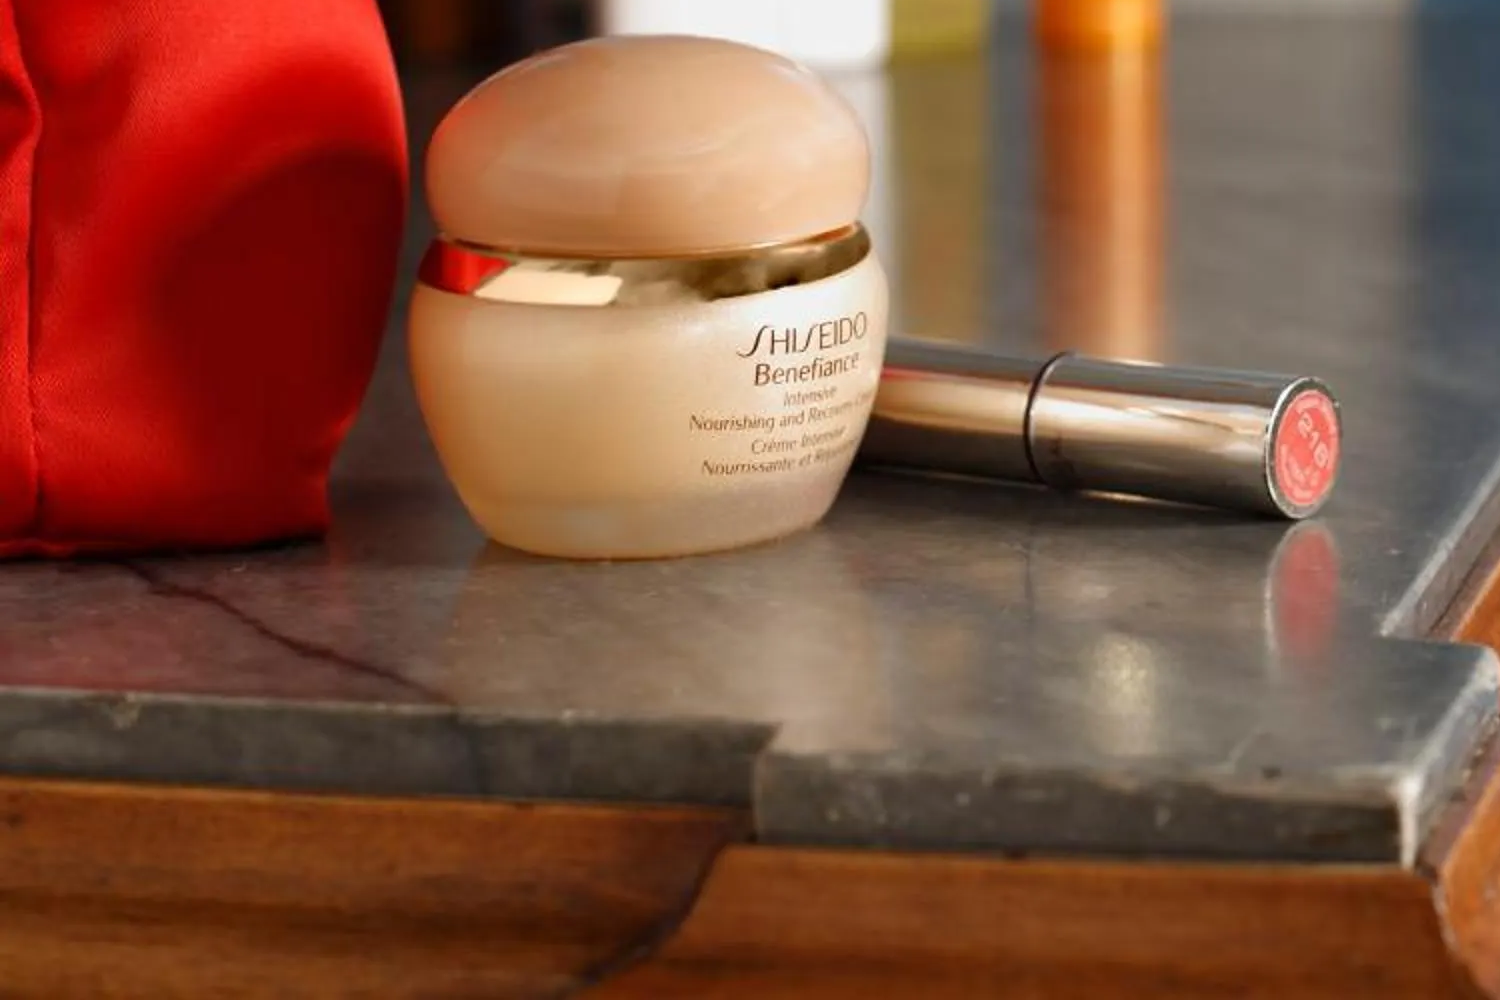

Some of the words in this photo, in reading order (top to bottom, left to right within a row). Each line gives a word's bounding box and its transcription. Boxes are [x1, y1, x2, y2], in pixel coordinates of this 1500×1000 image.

[736, 311, 867, 358] SHISEIDO
[754, 352, 859, 386] Benefiance
[689, 414, 775, 431] Nourishing
[780, 411, 805, 427] and
